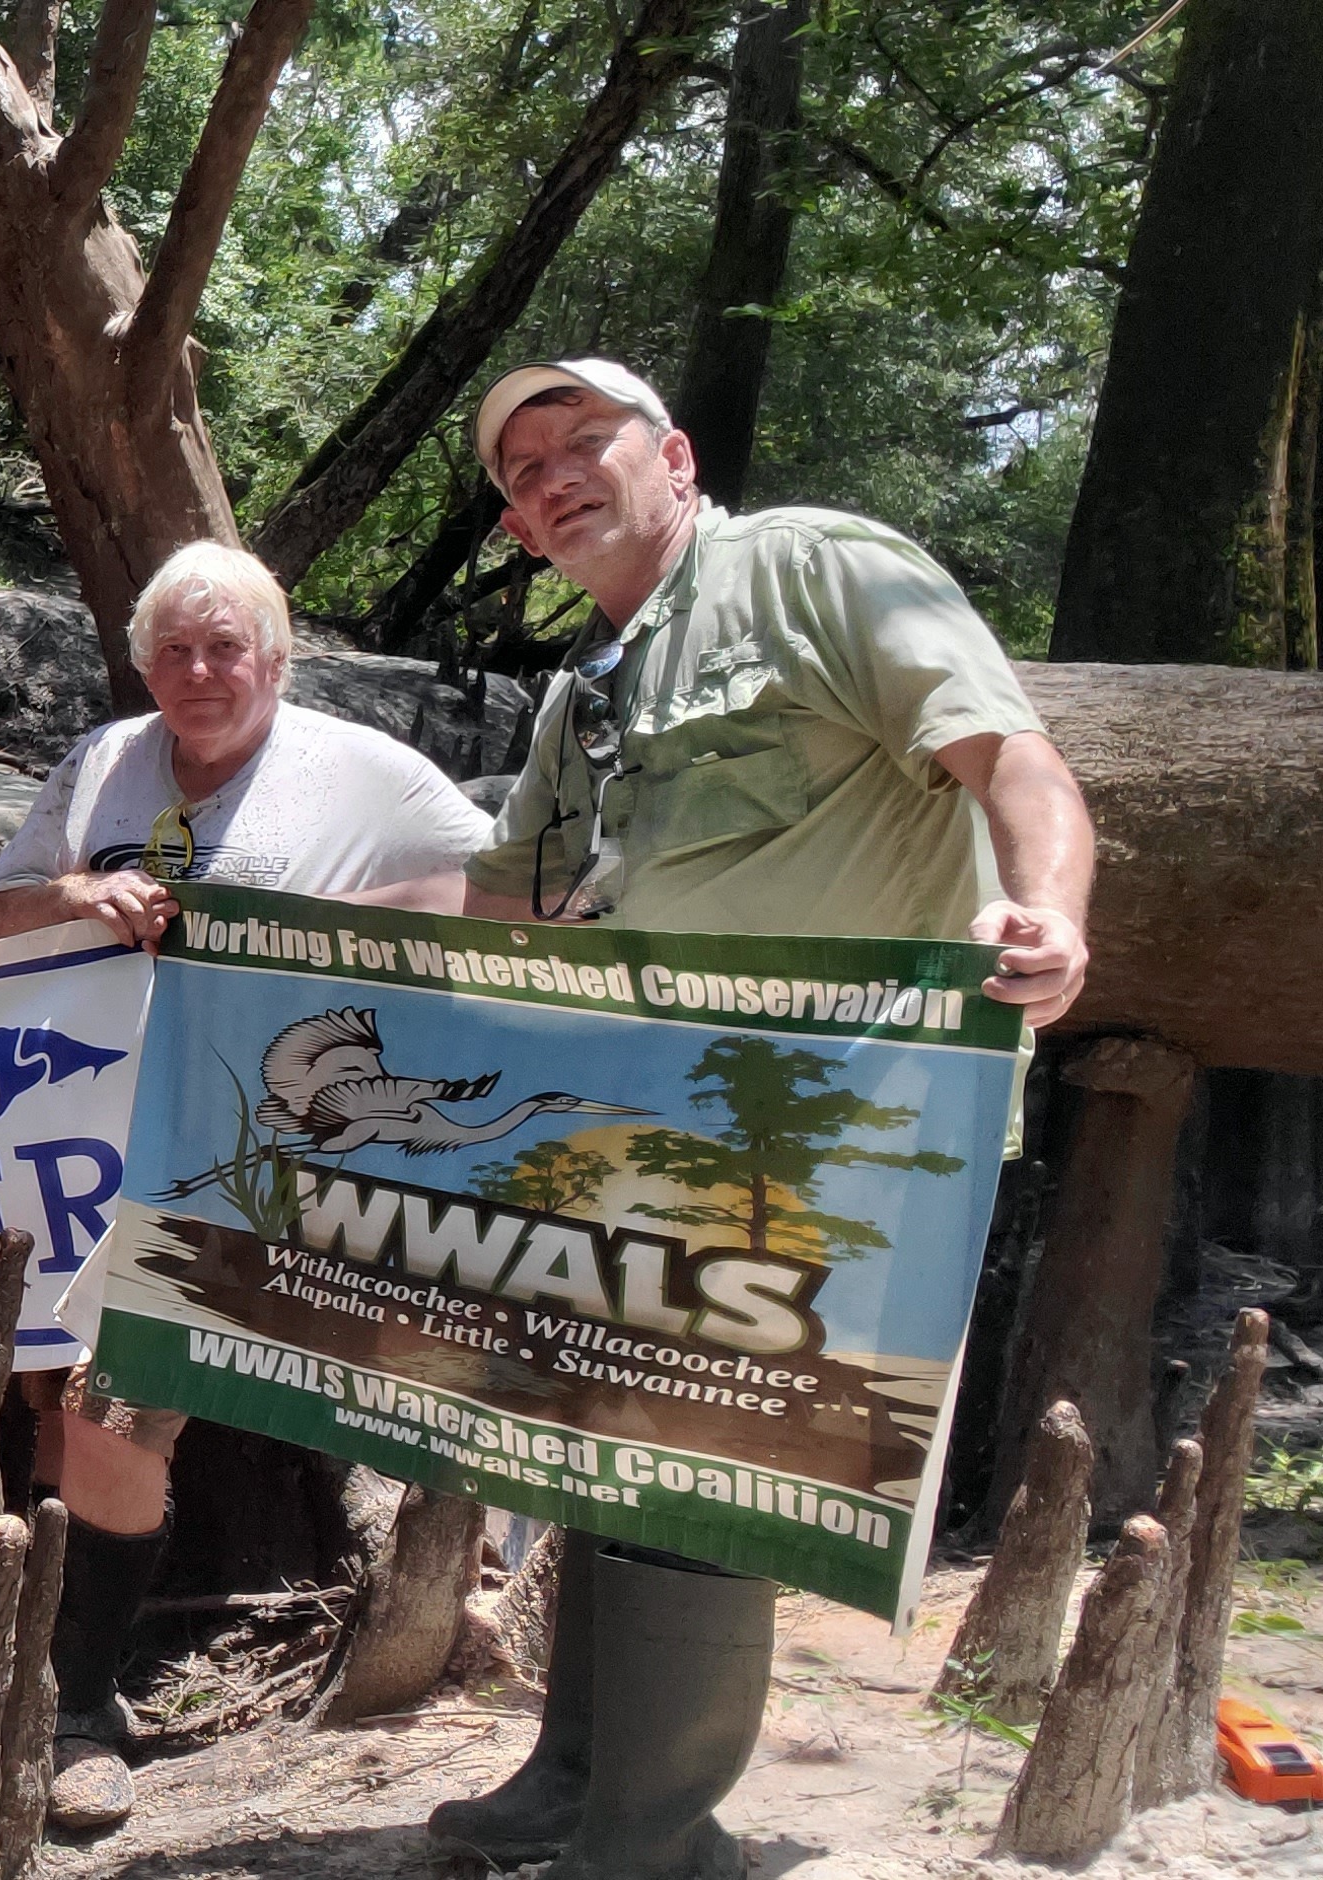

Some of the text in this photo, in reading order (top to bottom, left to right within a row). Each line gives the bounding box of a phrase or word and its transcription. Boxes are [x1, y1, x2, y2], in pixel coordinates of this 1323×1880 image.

[184, 911, 963, 1031] Working For Watershed Conservation
[265, 1244, 819, 1393] Withlacoochee Willacoochee
[293, 1169, 810, 1354] WWALS
[262, 1272, 787, 1417] Alapaha Little Suwannee
[188, 1329, 891, 1549] WWALS Watershed Coalition
[334, 1406, 642, 1508] www.wwals.net
